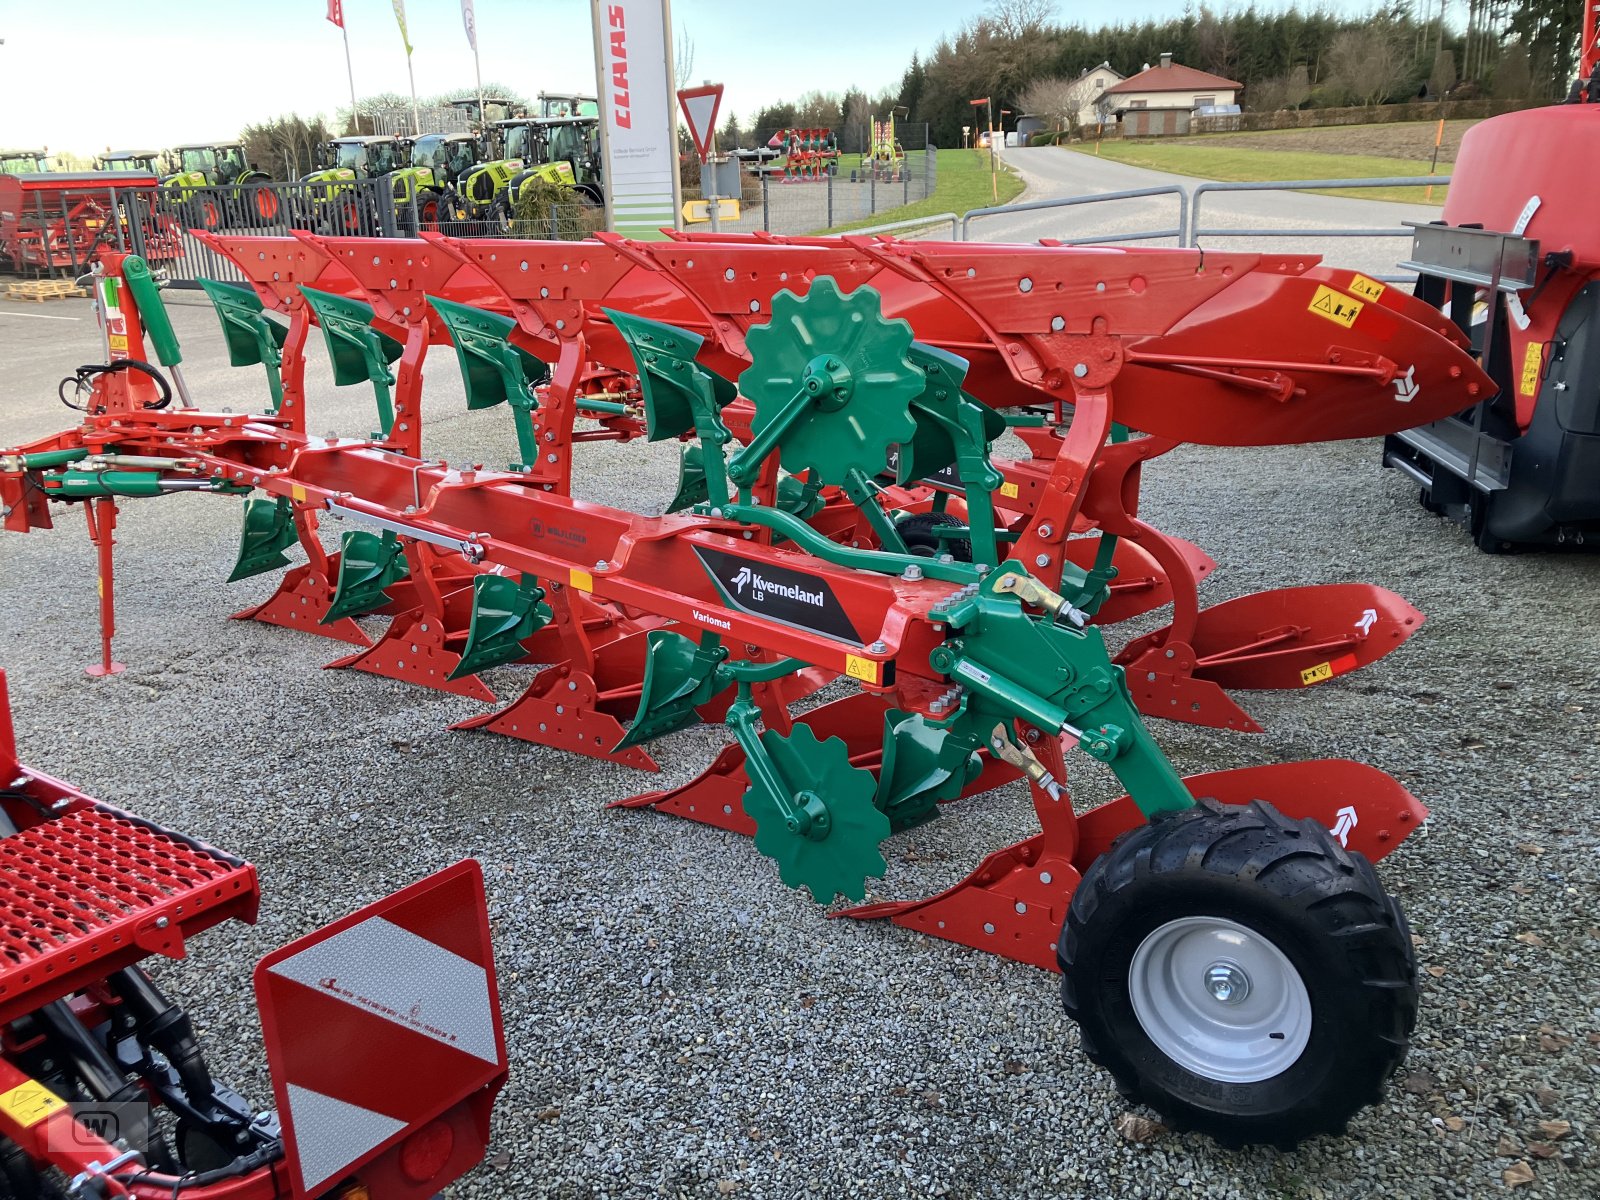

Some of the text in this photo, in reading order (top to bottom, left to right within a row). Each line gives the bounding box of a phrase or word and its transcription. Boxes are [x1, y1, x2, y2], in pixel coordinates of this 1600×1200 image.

[608, 5, 632, 130] CLAAS
[752, 573, 824, 608] Kverneland
[752, 589, 764, 602] LB
[692, 609, 731, 630] Variomat
